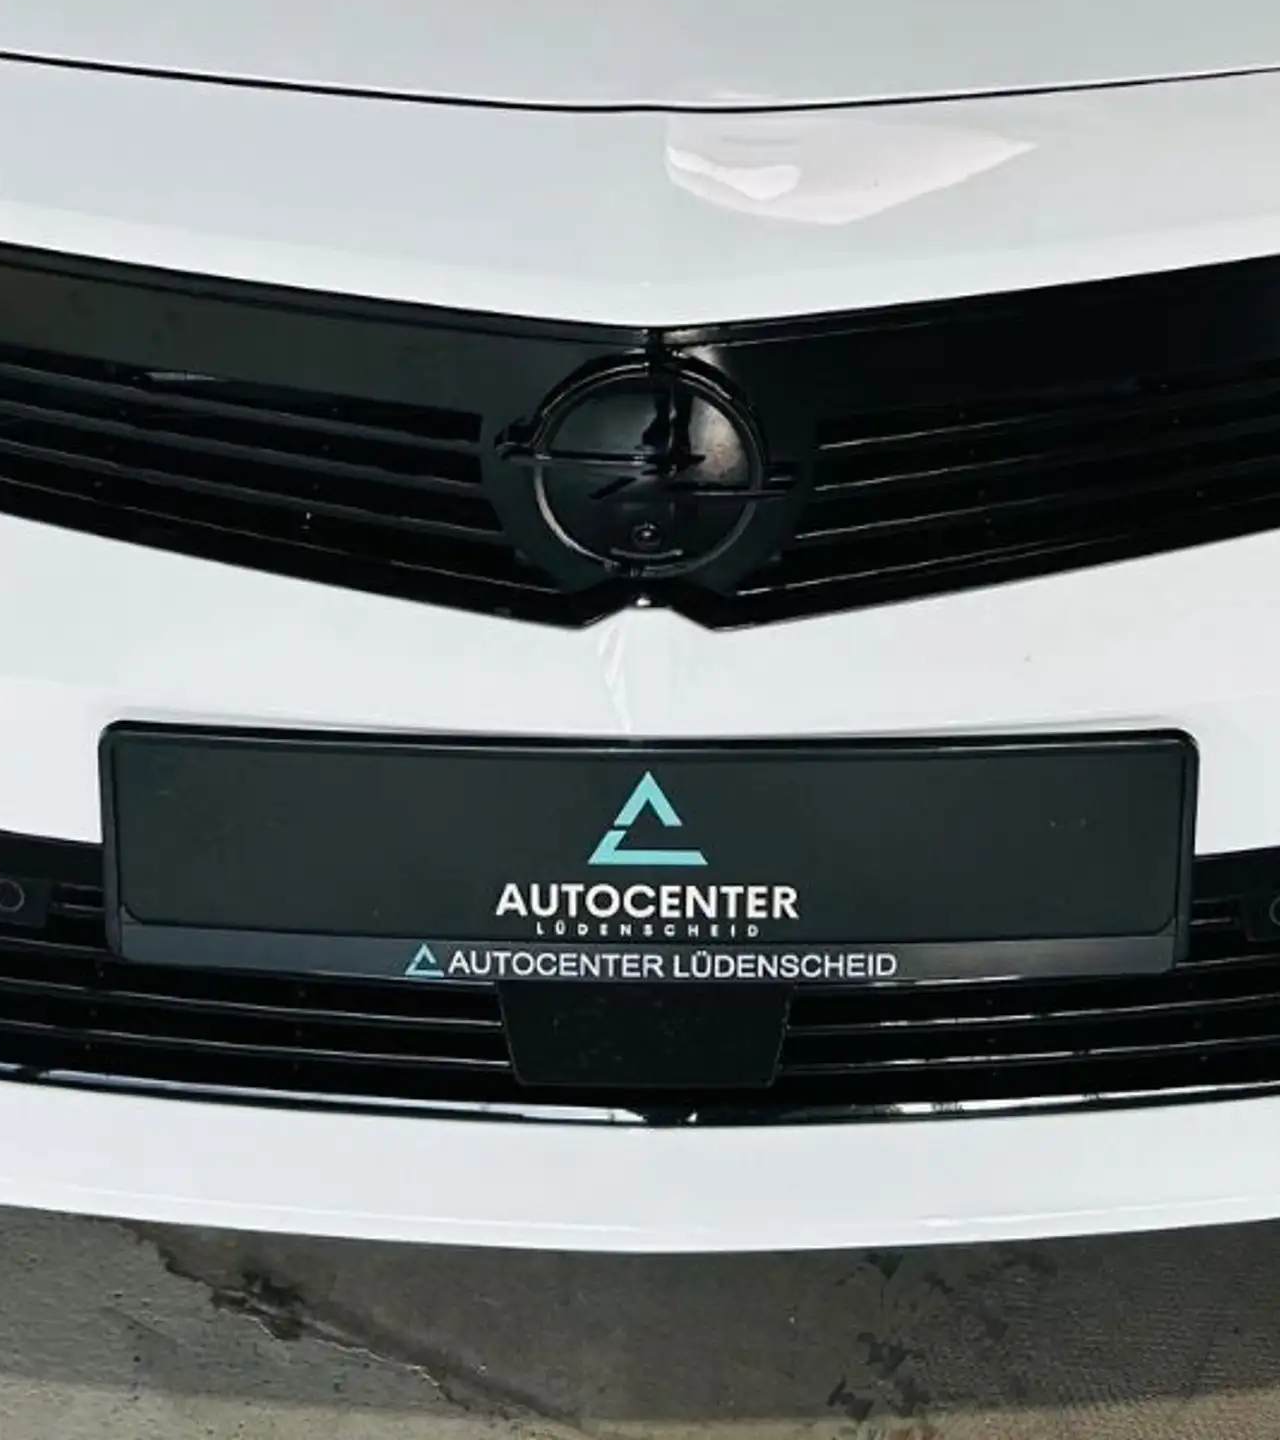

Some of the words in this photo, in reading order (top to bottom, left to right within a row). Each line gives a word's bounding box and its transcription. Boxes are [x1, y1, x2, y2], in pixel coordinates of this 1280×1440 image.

[495, 883, 800, 920] AUTOCENTER
[536, 921, 760, 937] LÜDENSCHEID
[447, 951, 664, 978] AUTOCENTER
[673, 949, 898, 978] LÜDENSCHEID
